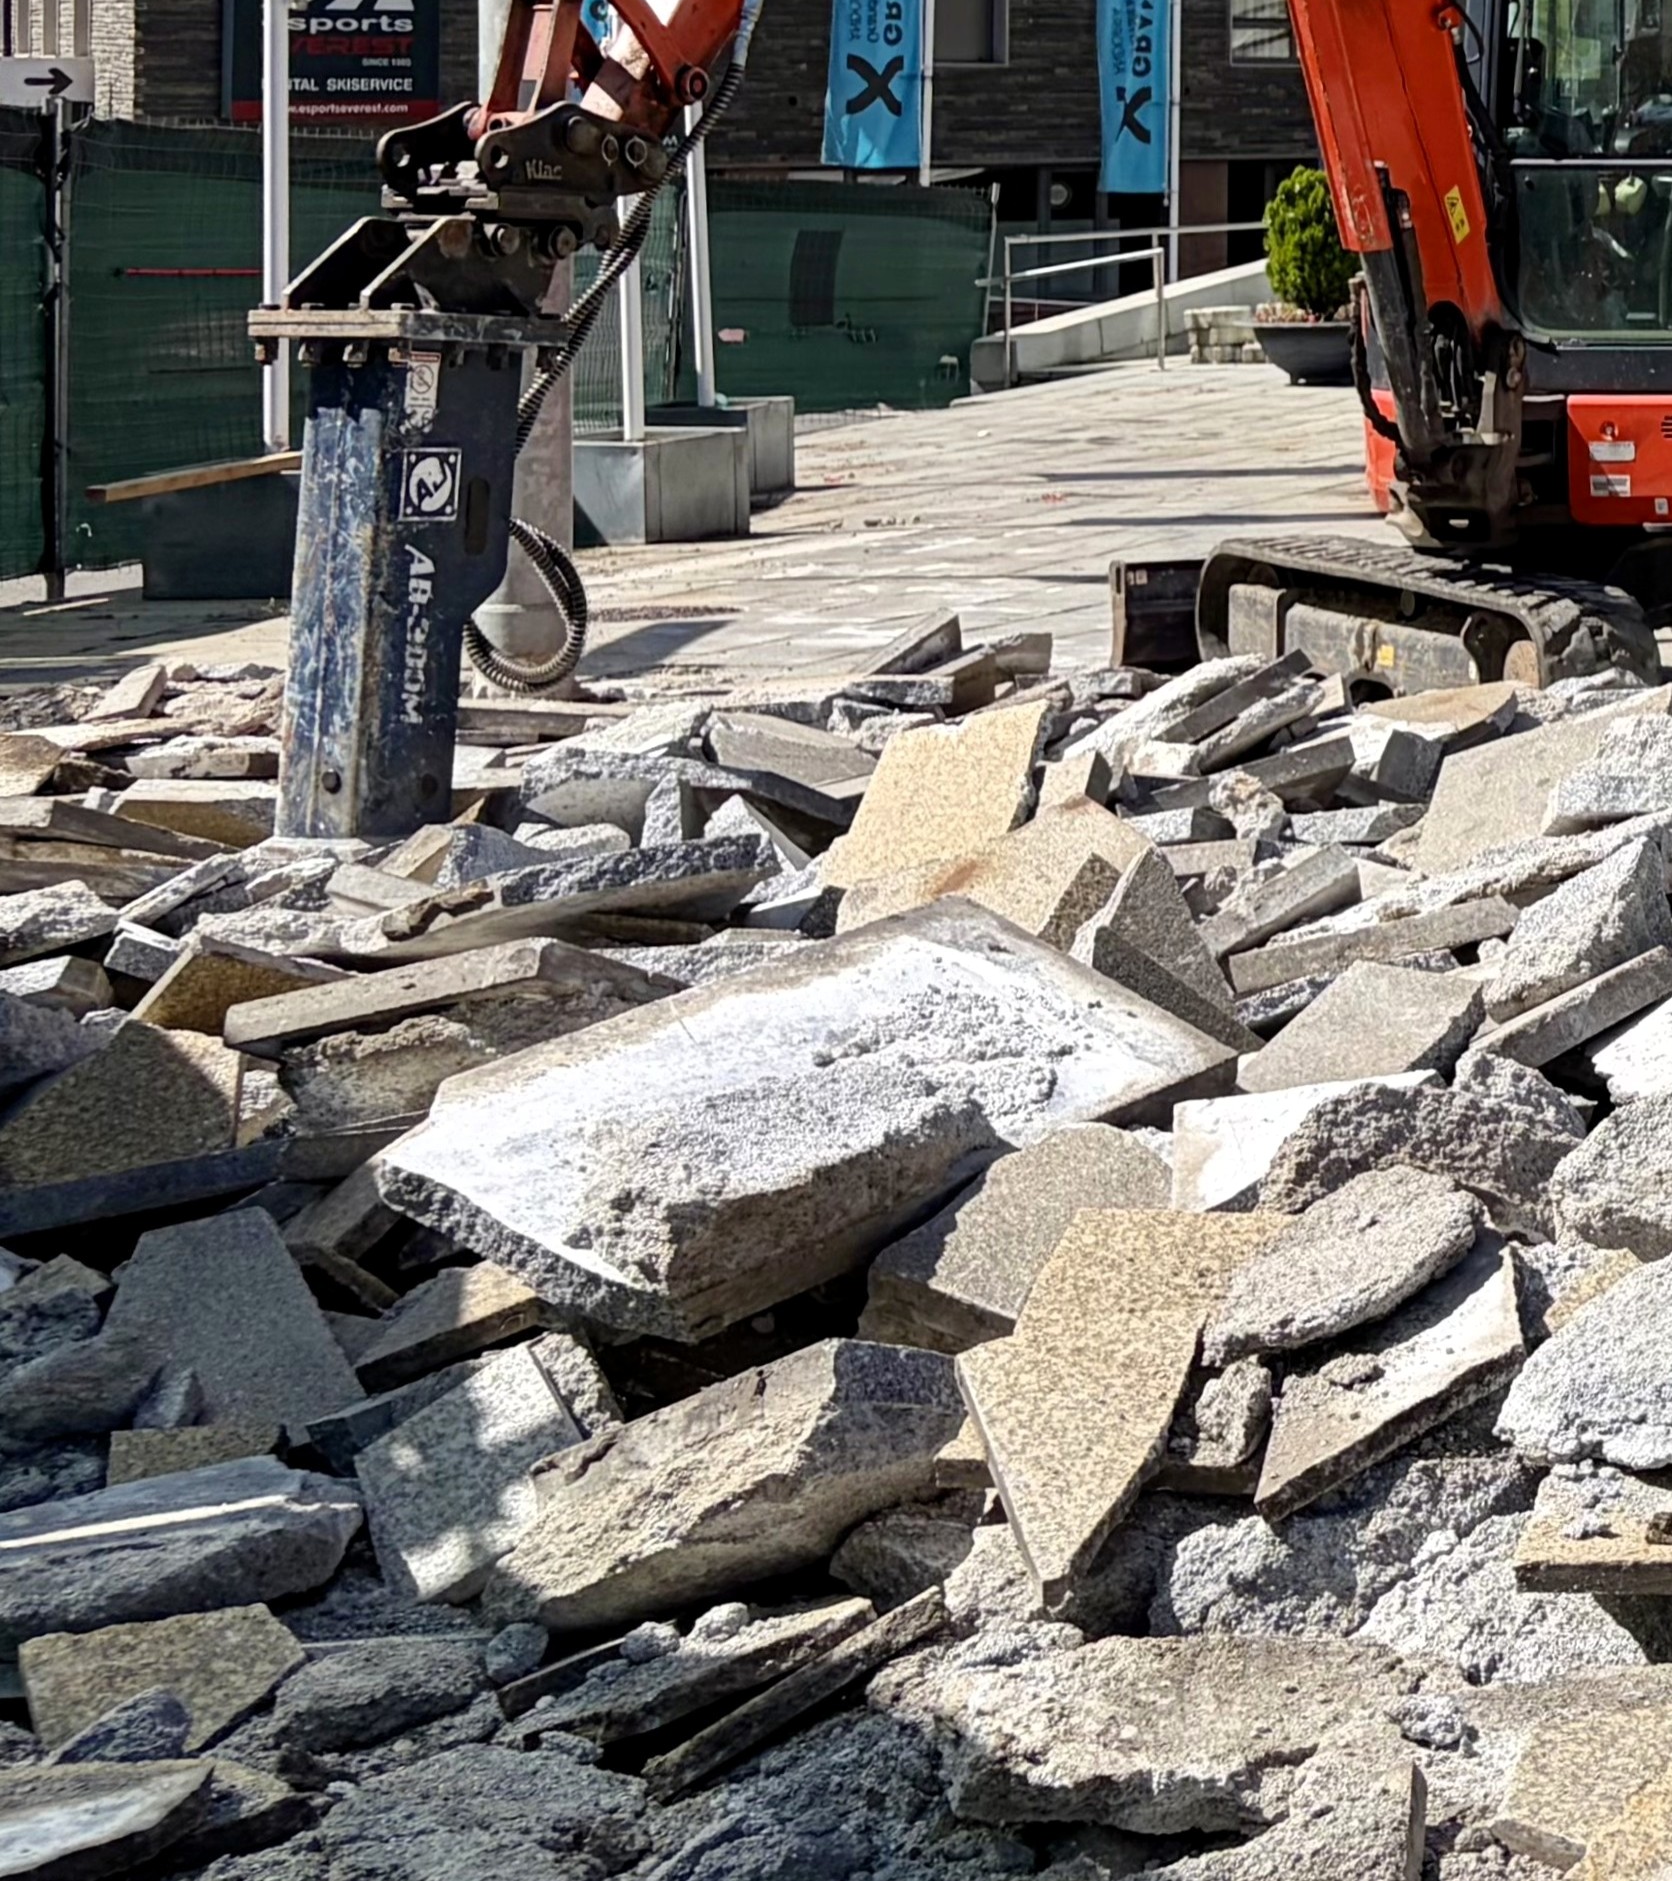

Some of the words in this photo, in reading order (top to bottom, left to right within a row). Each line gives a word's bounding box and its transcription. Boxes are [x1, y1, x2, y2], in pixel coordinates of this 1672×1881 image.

[287, 15, 414, 34] sports
[293, 36, 414, 56] EREST
[326, 77, 414, 92] SKISERVICE
[288, 102, 409, 116] .esportseverest.com
